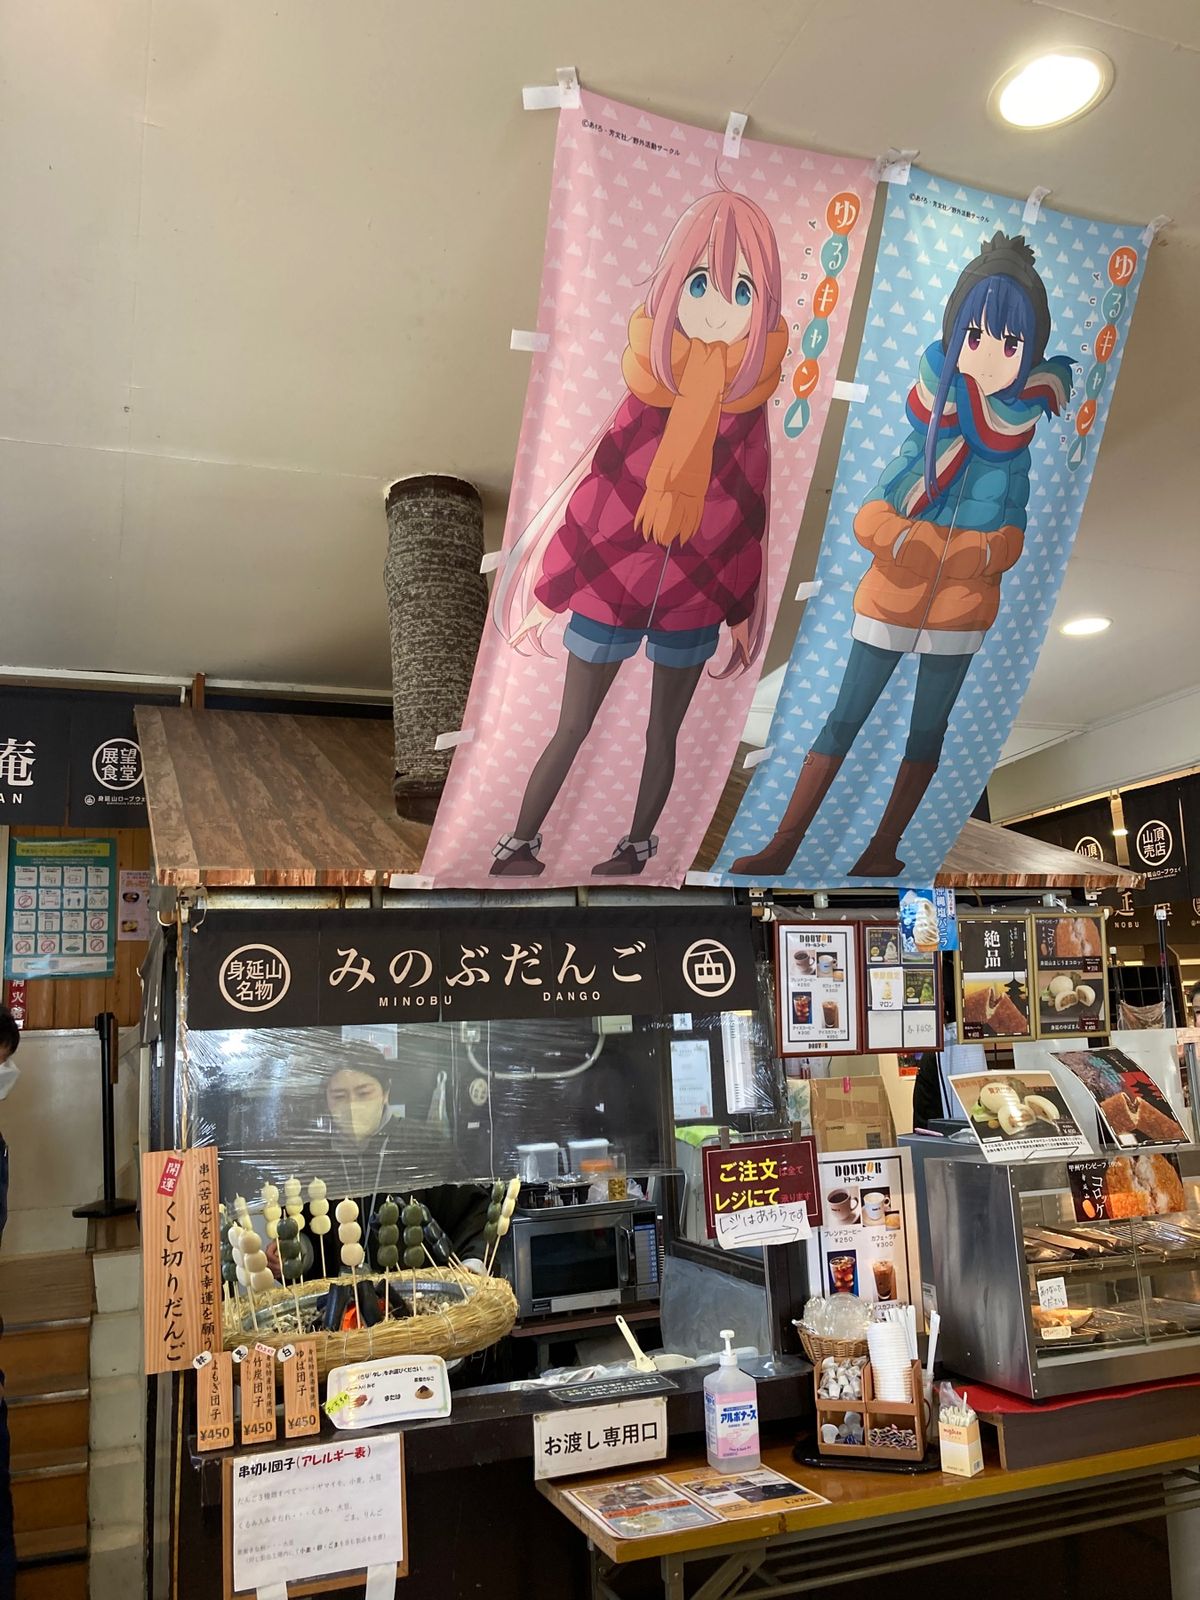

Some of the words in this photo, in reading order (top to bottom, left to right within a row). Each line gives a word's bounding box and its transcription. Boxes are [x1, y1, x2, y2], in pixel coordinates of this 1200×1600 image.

[101, 748, 137, 764] 展望
[101, 765, 137, 781] 食堂
[1142, 826, 1165, 845] 山頂
[1143, 842, 1166, 859] 売店
[983, 929, 1001, 969] 絶品
[227, 959, 283, 980] 身延山
[328, 941, 647, 993] みのぶだんご
[235, 980, 274, 1002] 名物
[379, 995, 453, 1007] MINOBU
[543, 991, 601, 1001] DANGO
[160, 1160, 181, 1194] 開運
[719, 1158, 779, 1182] ご注文
[835, 1161, 882, 1177] DOUTOR
[715, 1187, 780, 1212] レジにて
[1091, 1175, 1107, 1218] コロッケ
[719, 1207, 804, 1235] レジはあちらです
[161, 1200, 186, 1361] くし切りだんご
[253, 1356, 264, 1409] 竹炭団子
[287, 1414, 316, 1430] ¥450
[720, 1409, 757, 1424] アルボナース
[200, 1427, 230, 1441] ¥450
[243, 1421, 273, 1436] ¥450
[544, 1422, 659, 1456] お渡し専用口
[238, 1444, 372, 1479] 串切り団子(アレルギー表)
